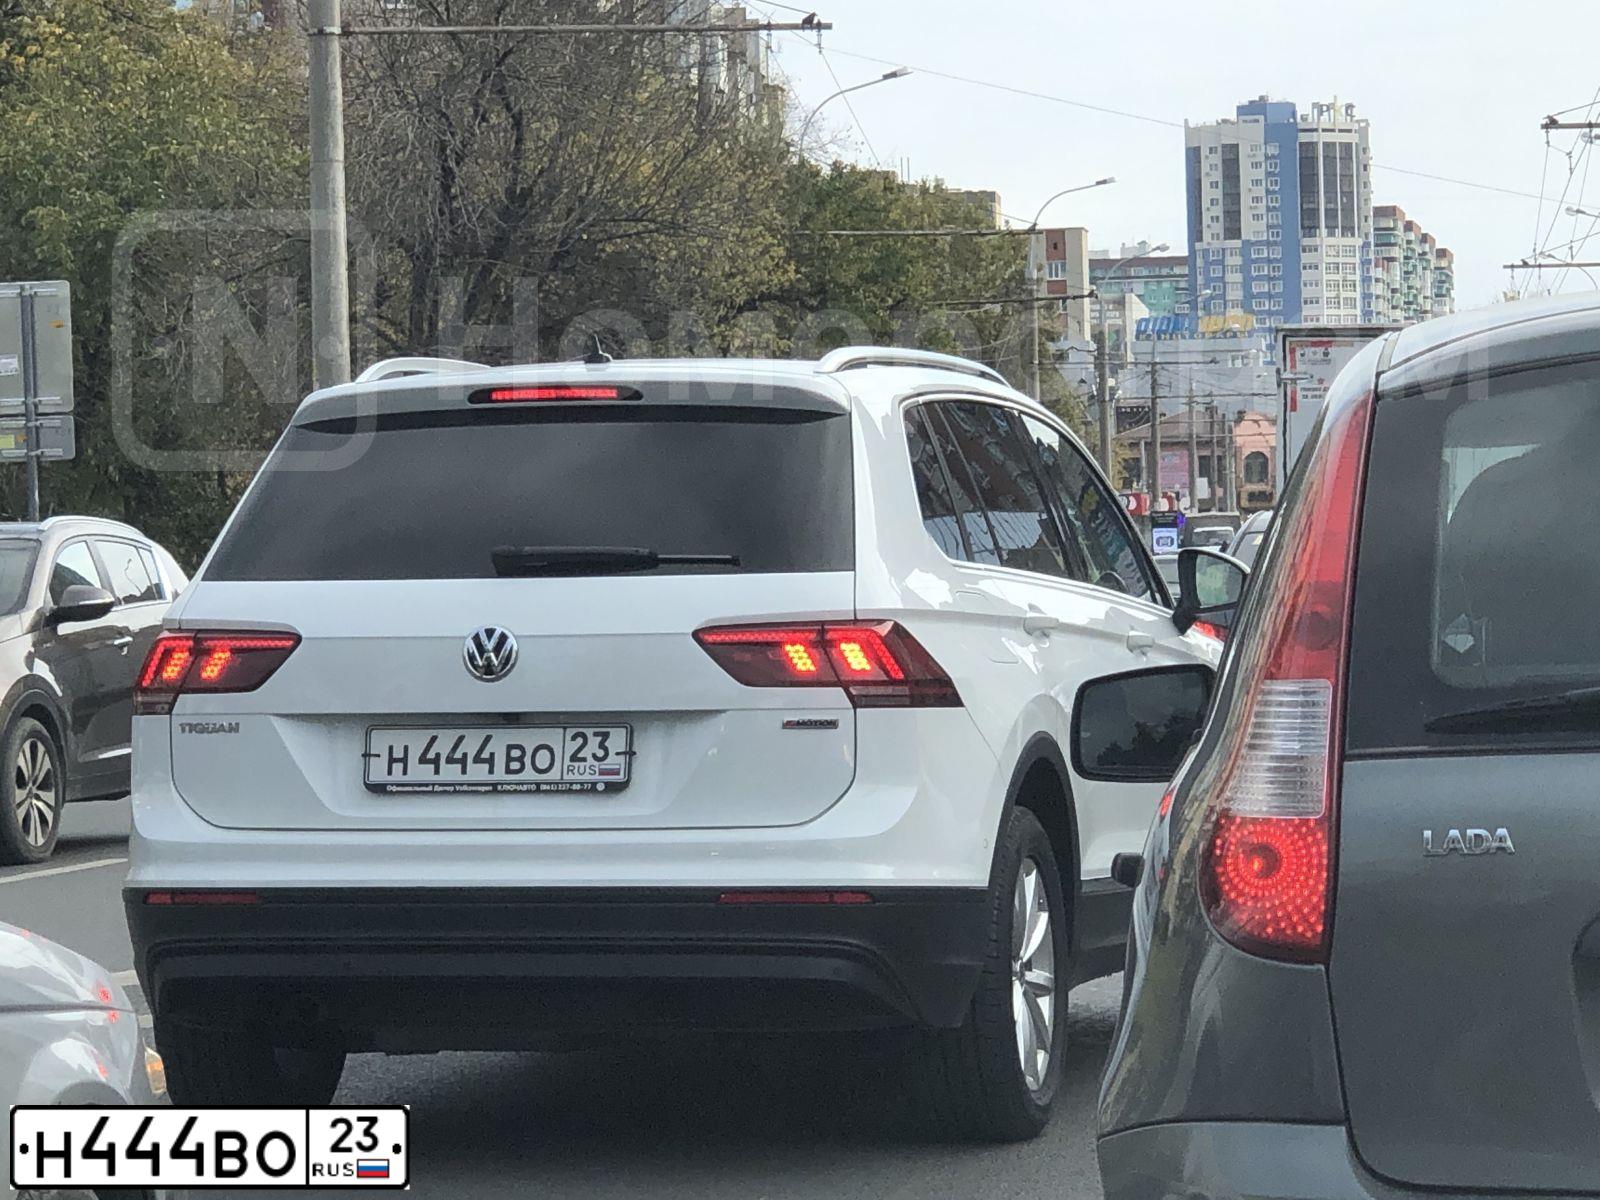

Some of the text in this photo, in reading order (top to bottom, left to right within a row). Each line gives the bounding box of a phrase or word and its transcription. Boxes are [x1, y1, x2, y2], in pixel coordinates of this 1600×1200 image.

[387, 734, 556, 776] Н444ВО
[569, 731, 611, 763] 23
[566, 764, 597, 776] RUS
[1422, 827, 1515, 857] LADA
